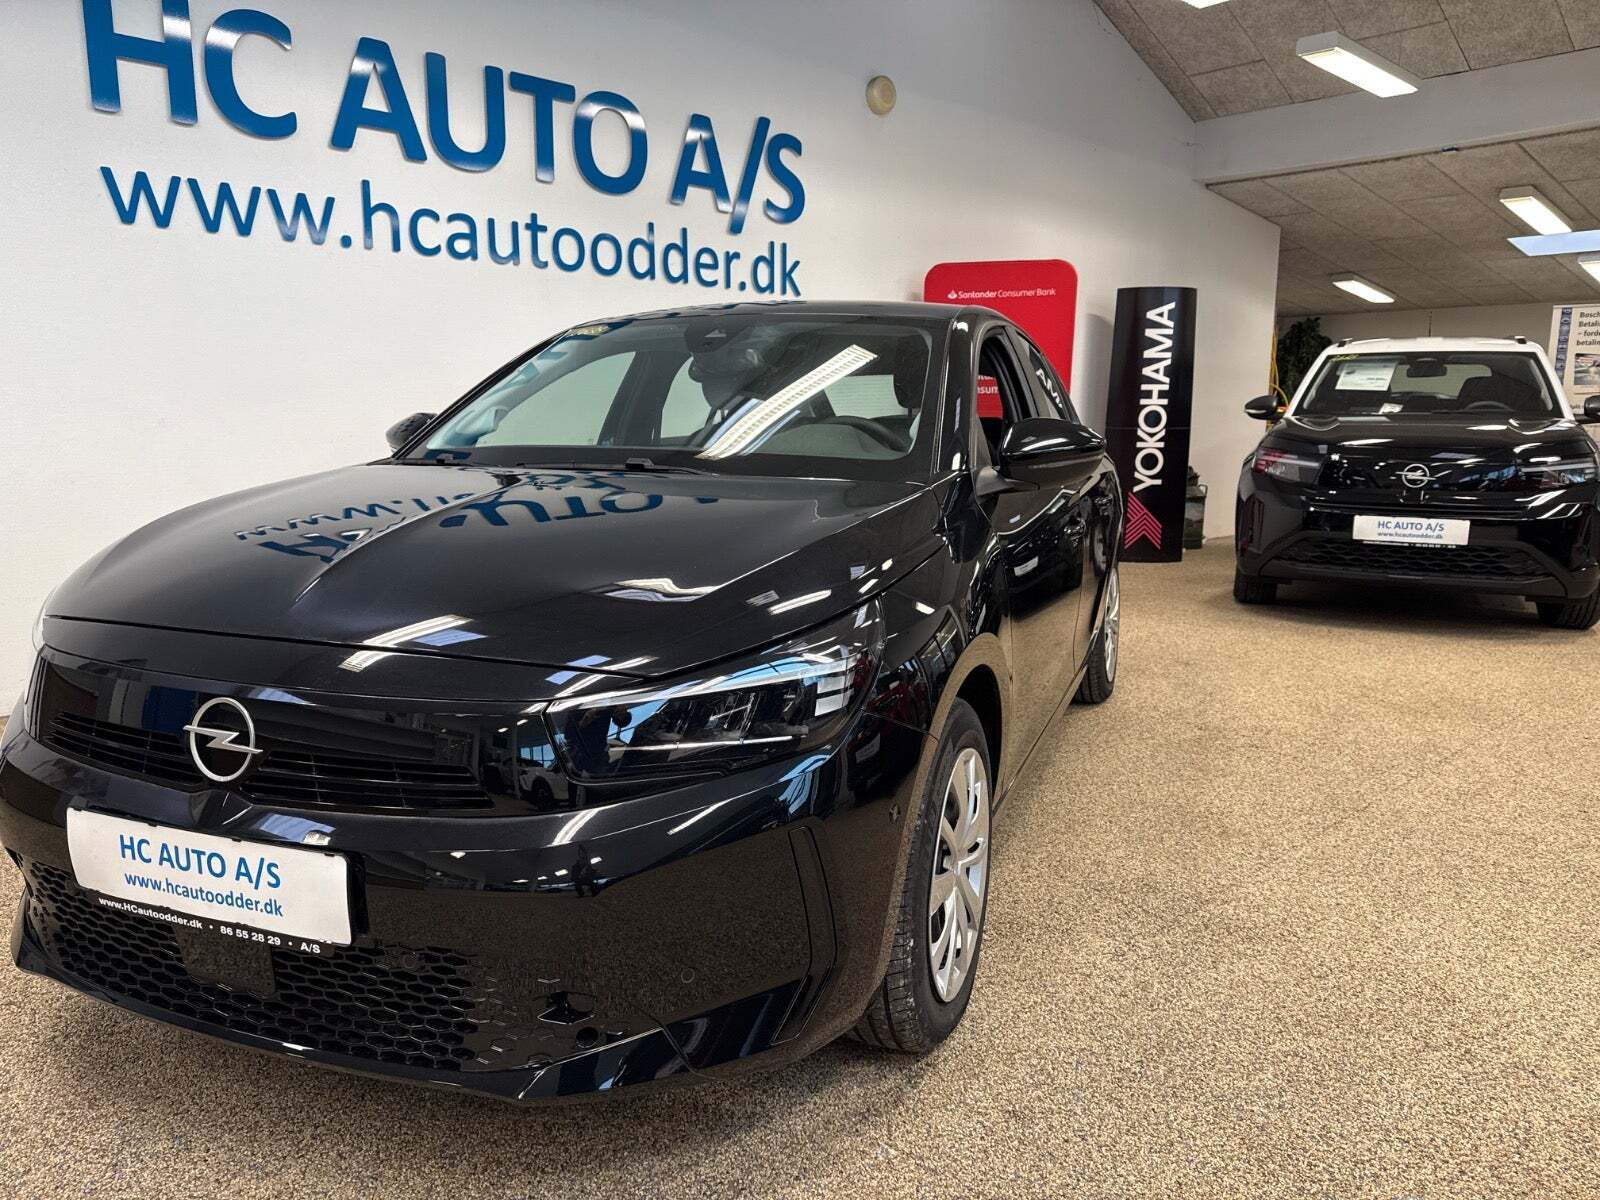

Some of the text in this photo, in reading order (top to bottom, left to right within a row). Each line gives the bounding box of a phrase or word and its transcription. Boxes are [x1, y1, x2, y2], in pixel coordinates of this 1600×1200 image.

[82, 0, 806, 235] HC AUTO A/S
[100, 165, 802, 297] www.hcautoodder.dk
[958, 287, 1057, 299] Santander Consumer Bank
[1133, 301, 1176, 493] YOKOHAMA
[1377, 520, 1445, 533] HC AUTO A/S
[119, 834, 281, 890] HC AUTO A/S
[124, 872, 284, 918] www.hcautoodder.dk
[98, 896, 203, 930] www.HCautoodder.dk
[220, 925, 234, 937] 86
[235, 928, 249, 940] 55
[251, 931, 265, 943] 28
[267, 934, 281, 946] 29
[300, 941, 321, 955] A/S
